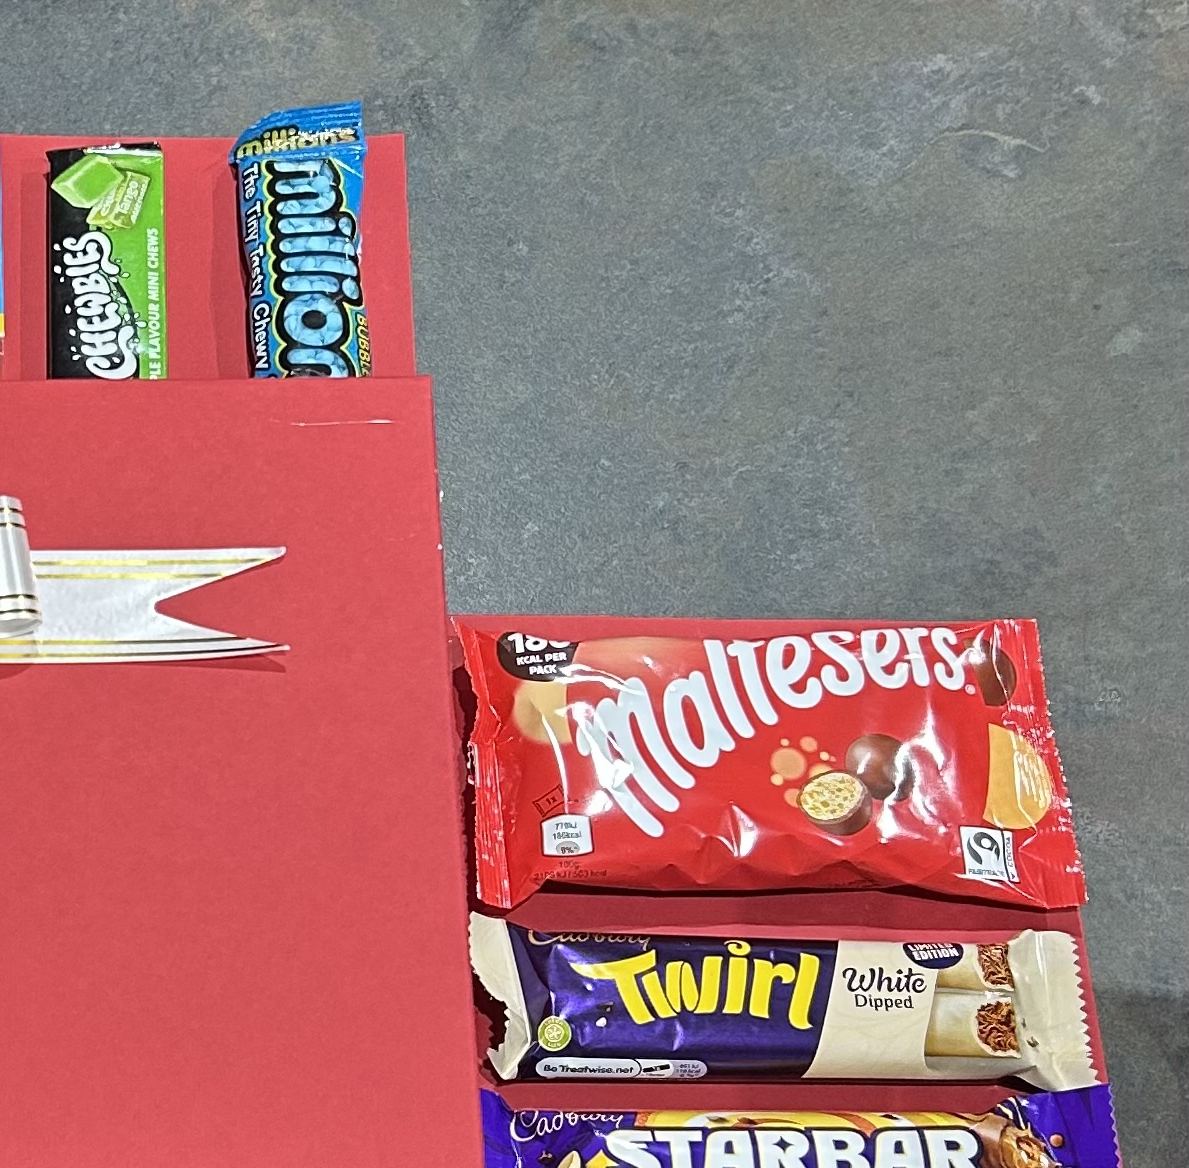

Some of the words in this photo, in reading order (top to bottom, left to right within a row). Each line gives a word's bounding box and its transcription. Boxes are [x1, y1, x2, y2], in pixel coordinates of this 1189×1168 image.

[243, 163, 260, 200] The
[244, 201, 262, 243] Tiny
[147, 227, 159, 269] CHEWS
[147, 271, 161, 301] MINI
[249, 243, 265, 297] Tasty
[62, 231, 138, 380] CHEWBIES
[148, 302, 161, 355] FLAVOUR
[515, 654, 543, 666] KCAL
[544, 652, 567, 663] PER
[528, 664, 557, 675] PACK
[912, 947, 959, 960] EDITION
[569, 940, 813, 1029] Twirl
[842, 967, 928, 994] White
[854, 994, 915, 1012] Dipped
[544, 1064, 558, 1073] Be
[559, 1064, 634, 1074] Treatwise.net
[509, 1110, 624, 1142] Cadbury
